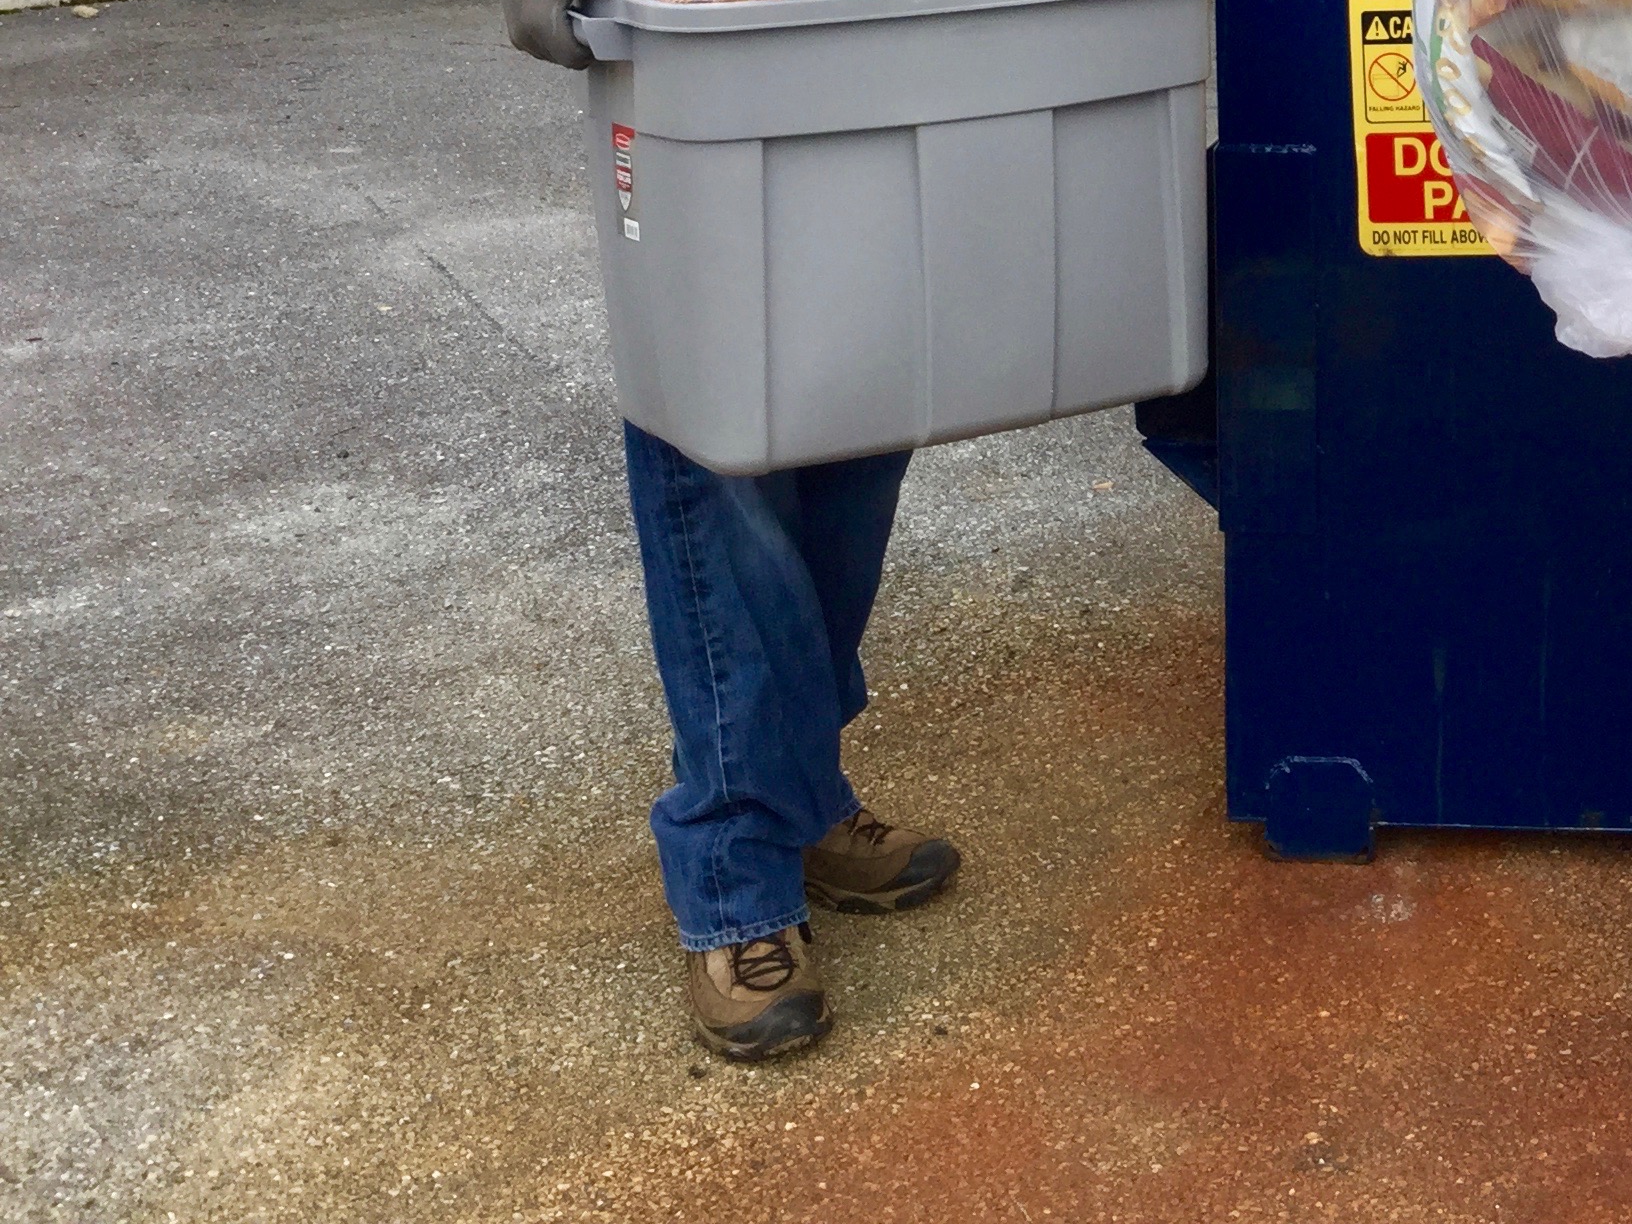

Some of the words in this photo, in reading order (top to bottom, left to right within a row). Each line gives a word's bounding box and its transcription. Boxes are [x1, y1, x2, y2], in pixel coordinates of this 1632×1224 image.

[1372, 230, 1390, 245] DO
[1393, 230, 1419, 245] NOT
[1422, 230, 1447, 245] FILL
